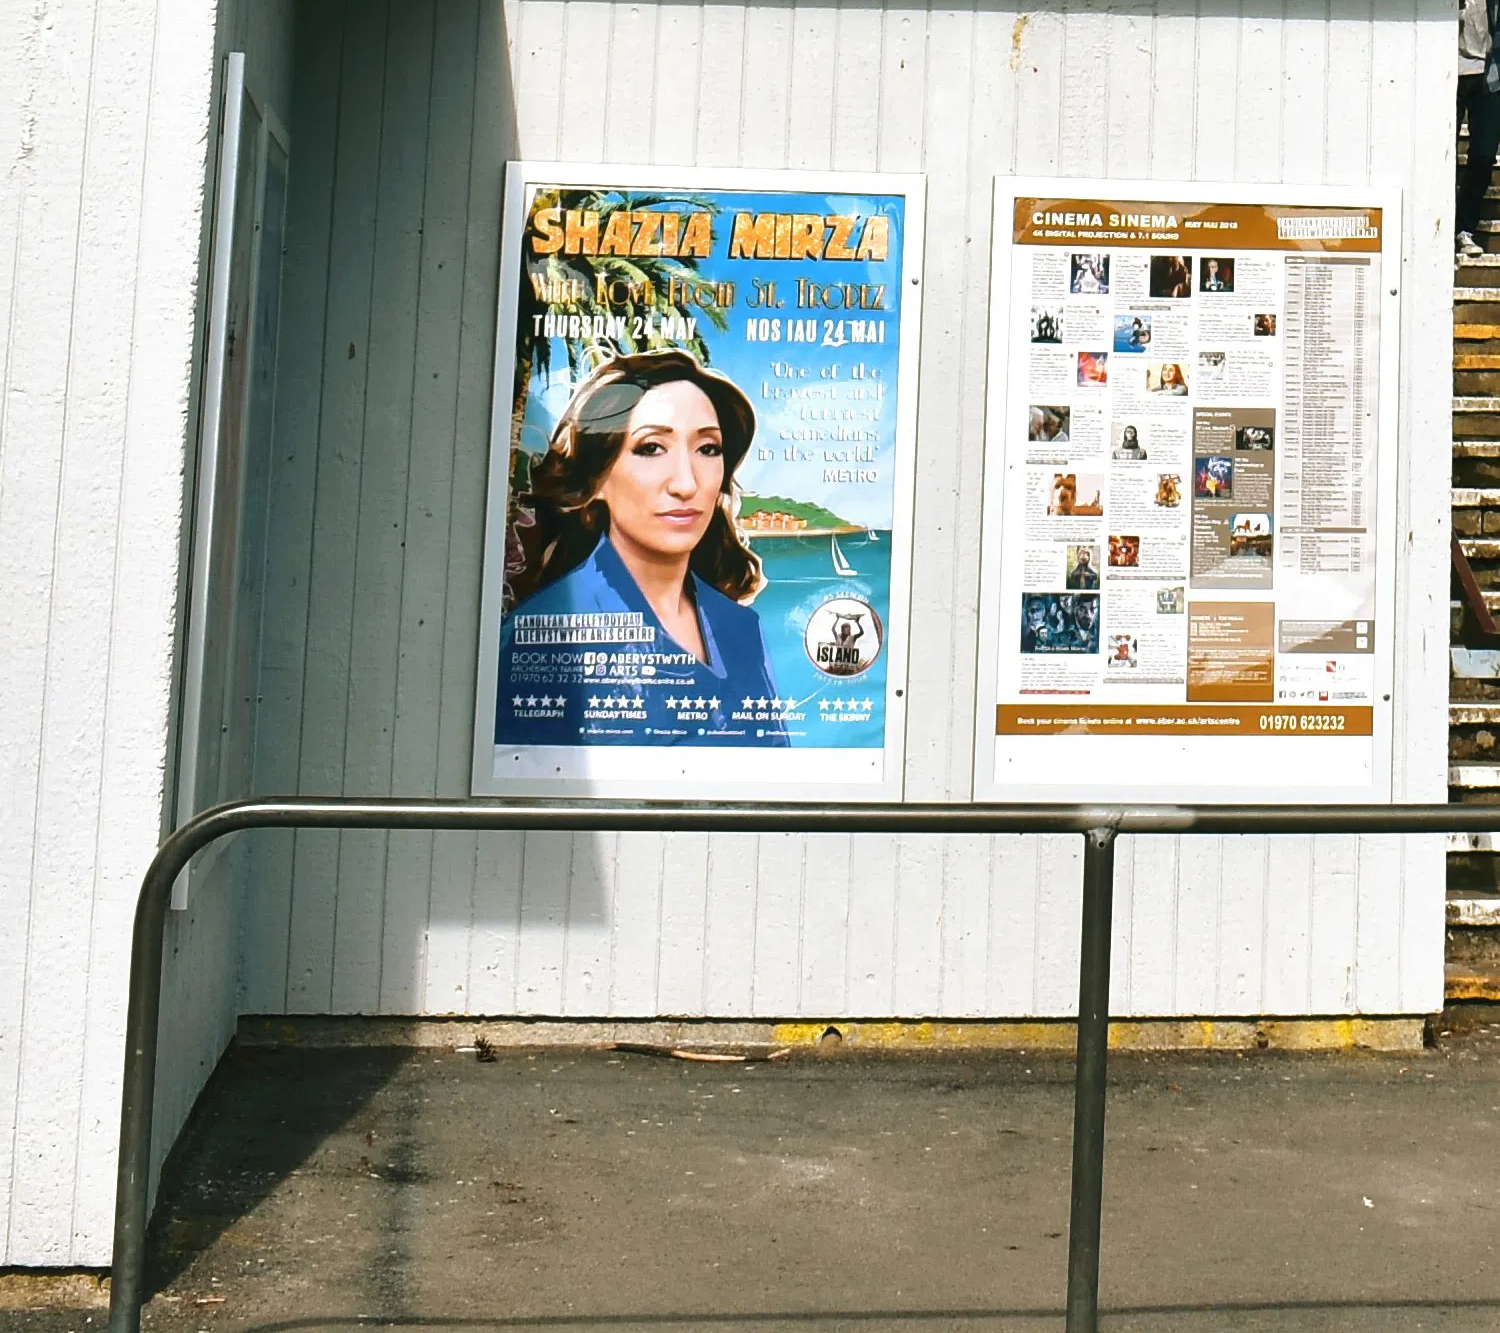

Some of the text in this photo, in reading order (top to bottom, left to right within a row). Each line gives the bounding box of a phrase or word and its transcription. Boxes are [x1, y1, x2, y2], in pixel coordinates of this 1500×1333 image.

[1032, 212, 1103, 227] CINEMA
[1109, 214, 1178, 228] SINEMA
[532, 207, 889, 261] SHAZIA MIRZA
[532, 314, 697, 340] THURSDAY 24 MAY
[747, 318, 885, 344] NOS IAU 24 MAI
[822, 468, 879, 484] METRO
[512, 652, 583, 664] BOOK NOW
[609, 653, 696, 665] ABERYSTWYTH
[817, 646, 859, 664] ISLAND
[609, 665, 638, 677] ARTS
[510, 674, 540, 683] 01970
[514, 709, 565, 718] TELEGRAPH
[583, 709, 619, 719] SUNDAY
[677, 711, 709, 721] METRO
[1259, 715, 1345, 731] 01970 623232
